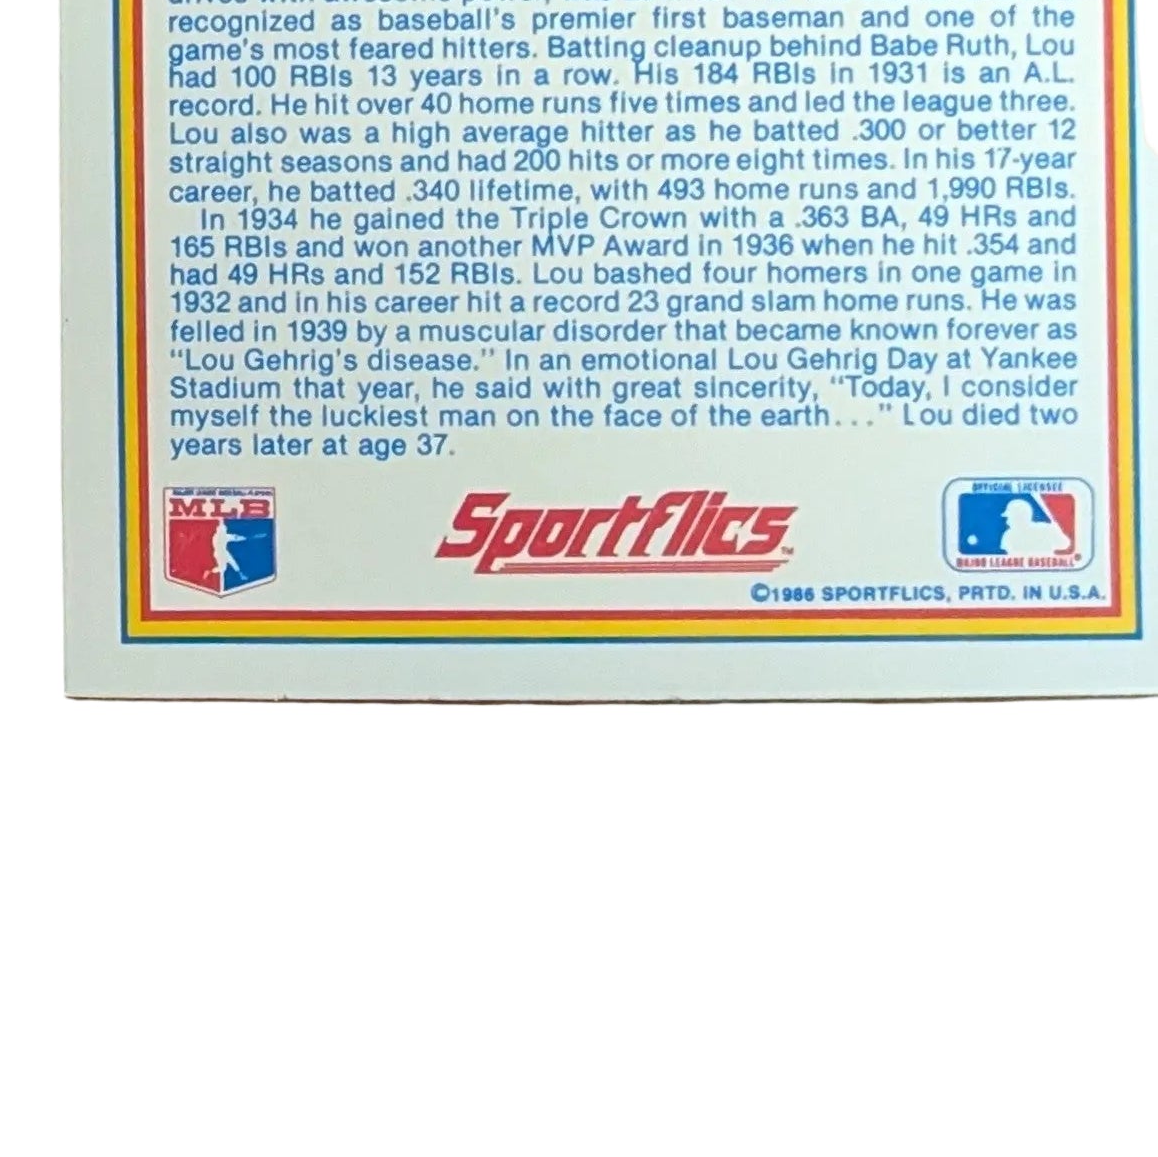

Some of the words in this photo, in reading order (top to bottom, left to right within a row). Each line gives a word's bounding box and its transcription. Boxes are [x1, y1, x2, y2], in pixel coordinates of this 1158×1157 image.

[168, 10, 316, 39] recognized
[329, 14, 363, 32] as
[531, 8, 637, 36] premier
[651, 7, 707, 29] first
[722, 6, 845, 29] baseman
[859, 6, 910, 28] and
[924, 10, 976, 28] one
[989, 5, 1018, 27] of
[1031, 5, 1077, 27] the
[272, 38, 341, 60] most
[348, 37, 435, 60] feared
[441, 36, 538, 59] hitters.
[546, 36, 647, 64] Batting
[653, 35, 763, 64] cleanup
[769, 34, 863, 57] behind
[869, 34, 940, 56] Babe
[945, 33, 1018, 60] Ruth,
[1025, 33, 1076, 55] Lou
[168, 122, 219, 144] Lou
[229, 122, 288, 144] also
[298, 126, 353, 144] was
[363, 126, 381, 143] a
[391, 121, 451, 149] high
[461, 125, 570, 149] average
[580, 120, 655, 142] hitter
[664, 125, 698, 142] as
[708, 120, 743, 142] he
[752, 119, 840, 142] batted
[852, 119, 907, 141] .300
[917, 124, 947, 141] or
[956, 118, 1038, 141] better
[1047, 118, 1077, 140] 12
[168, 185, 259, 207] career,
[265, 180, 302, 202] he
[309, 180, 396, 202] batted
[405, 180, 461, 202] .340
[469, 179, 582, 205] lifetime,
[589, 179, 649, 201] with
[656, 178, 707, 201] 493
[713, 178, 791, 200] home
[798, 183, 860, 200] runs
[866, 178, 917, 200] and
[927, 177, 998, 203] 1,990
[1005, 177, 1076, 199] RBIs.
[169, 264, 219, 286] had
[226, 263, 259, 286] 49
[268, 263, 326, 285] HRs
[333, 263, 385, 285] and
[393, 263, 441, 285] 152
[449, 262, 523, 285] RBIs.
[532, 262, 584, 284] Lou
[592, 262, 693, 284] bashed
[701, 262, 759, 284] four
[766, 261, 869, 284] homers
[877, 261, 903, 283] in
[910, 266, 962, 283] one
[969, 266, 1044, 289] game
[1053, 261, 1077, 283] in
[505, 349, 531, 371] In
[538, 354, 572, 371] an
[580, 348, 718, 371] emotional
[727, 348, 779, 370] Lou
[786, 348, 879, 376] Gehrig
[886, 348, 939, 376] Day
[945, 348, 972, 370] at
[980, 348, 1079, 370] Yankee
[170, 438, 243, 462] years
[252, 434, 315, 456] later
[321, 434, 350, 456] at
[357, 439, 408, 462] age
[416, 434, 456, 456] 37.
[169, 497, 270, 518] MLB
[434, 490, 798, 574] Sportflics
[822, 585, 952, 603] SPORTFLICS,
[959, 585, 1016, 601] PRTD.
[1024, 585, 1042, 601] IN
[1049, 584, 1107, 601] U.S.A.
